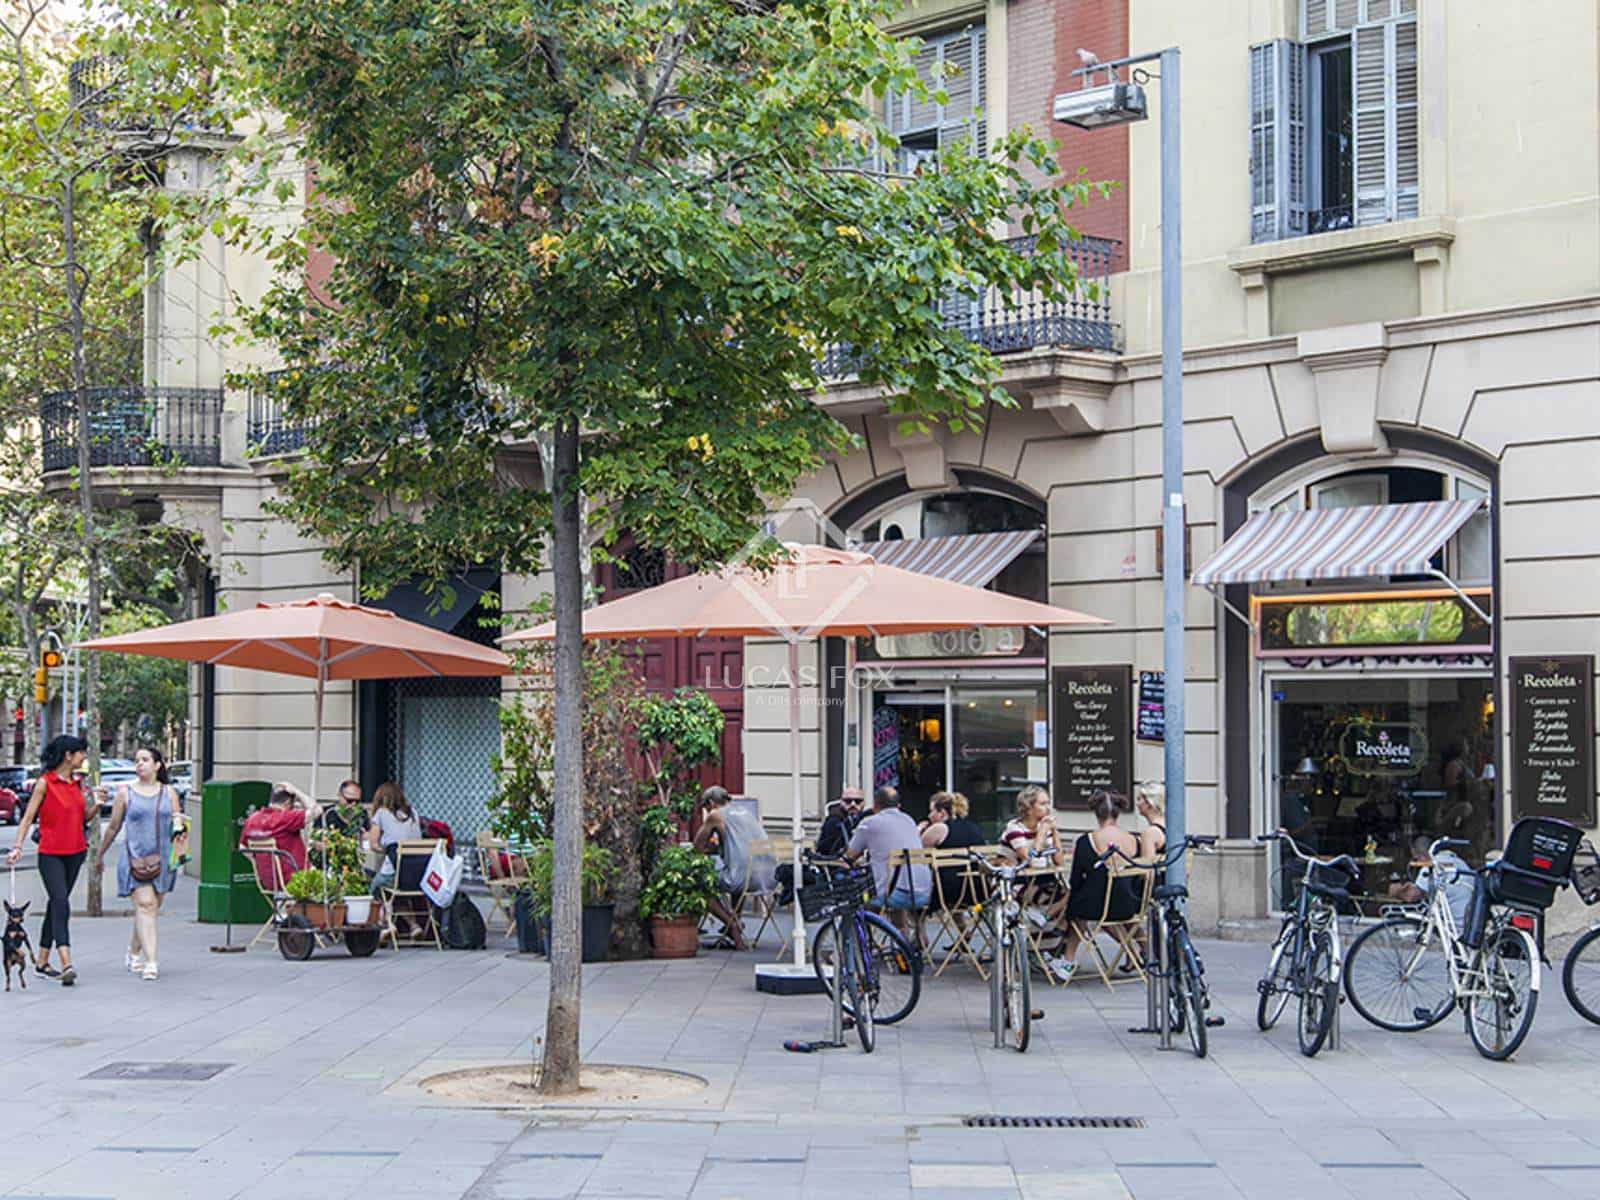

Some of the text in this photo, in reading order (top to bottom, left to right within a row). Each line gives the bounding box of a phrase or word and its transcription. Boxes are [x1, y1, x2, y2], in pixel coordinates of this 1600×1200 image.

[1068, 680, 1113, 695] Recoleta
[1523, 673, 1576, 688] Recoleta
[1356, 740, 1411, 756] Recoleta
